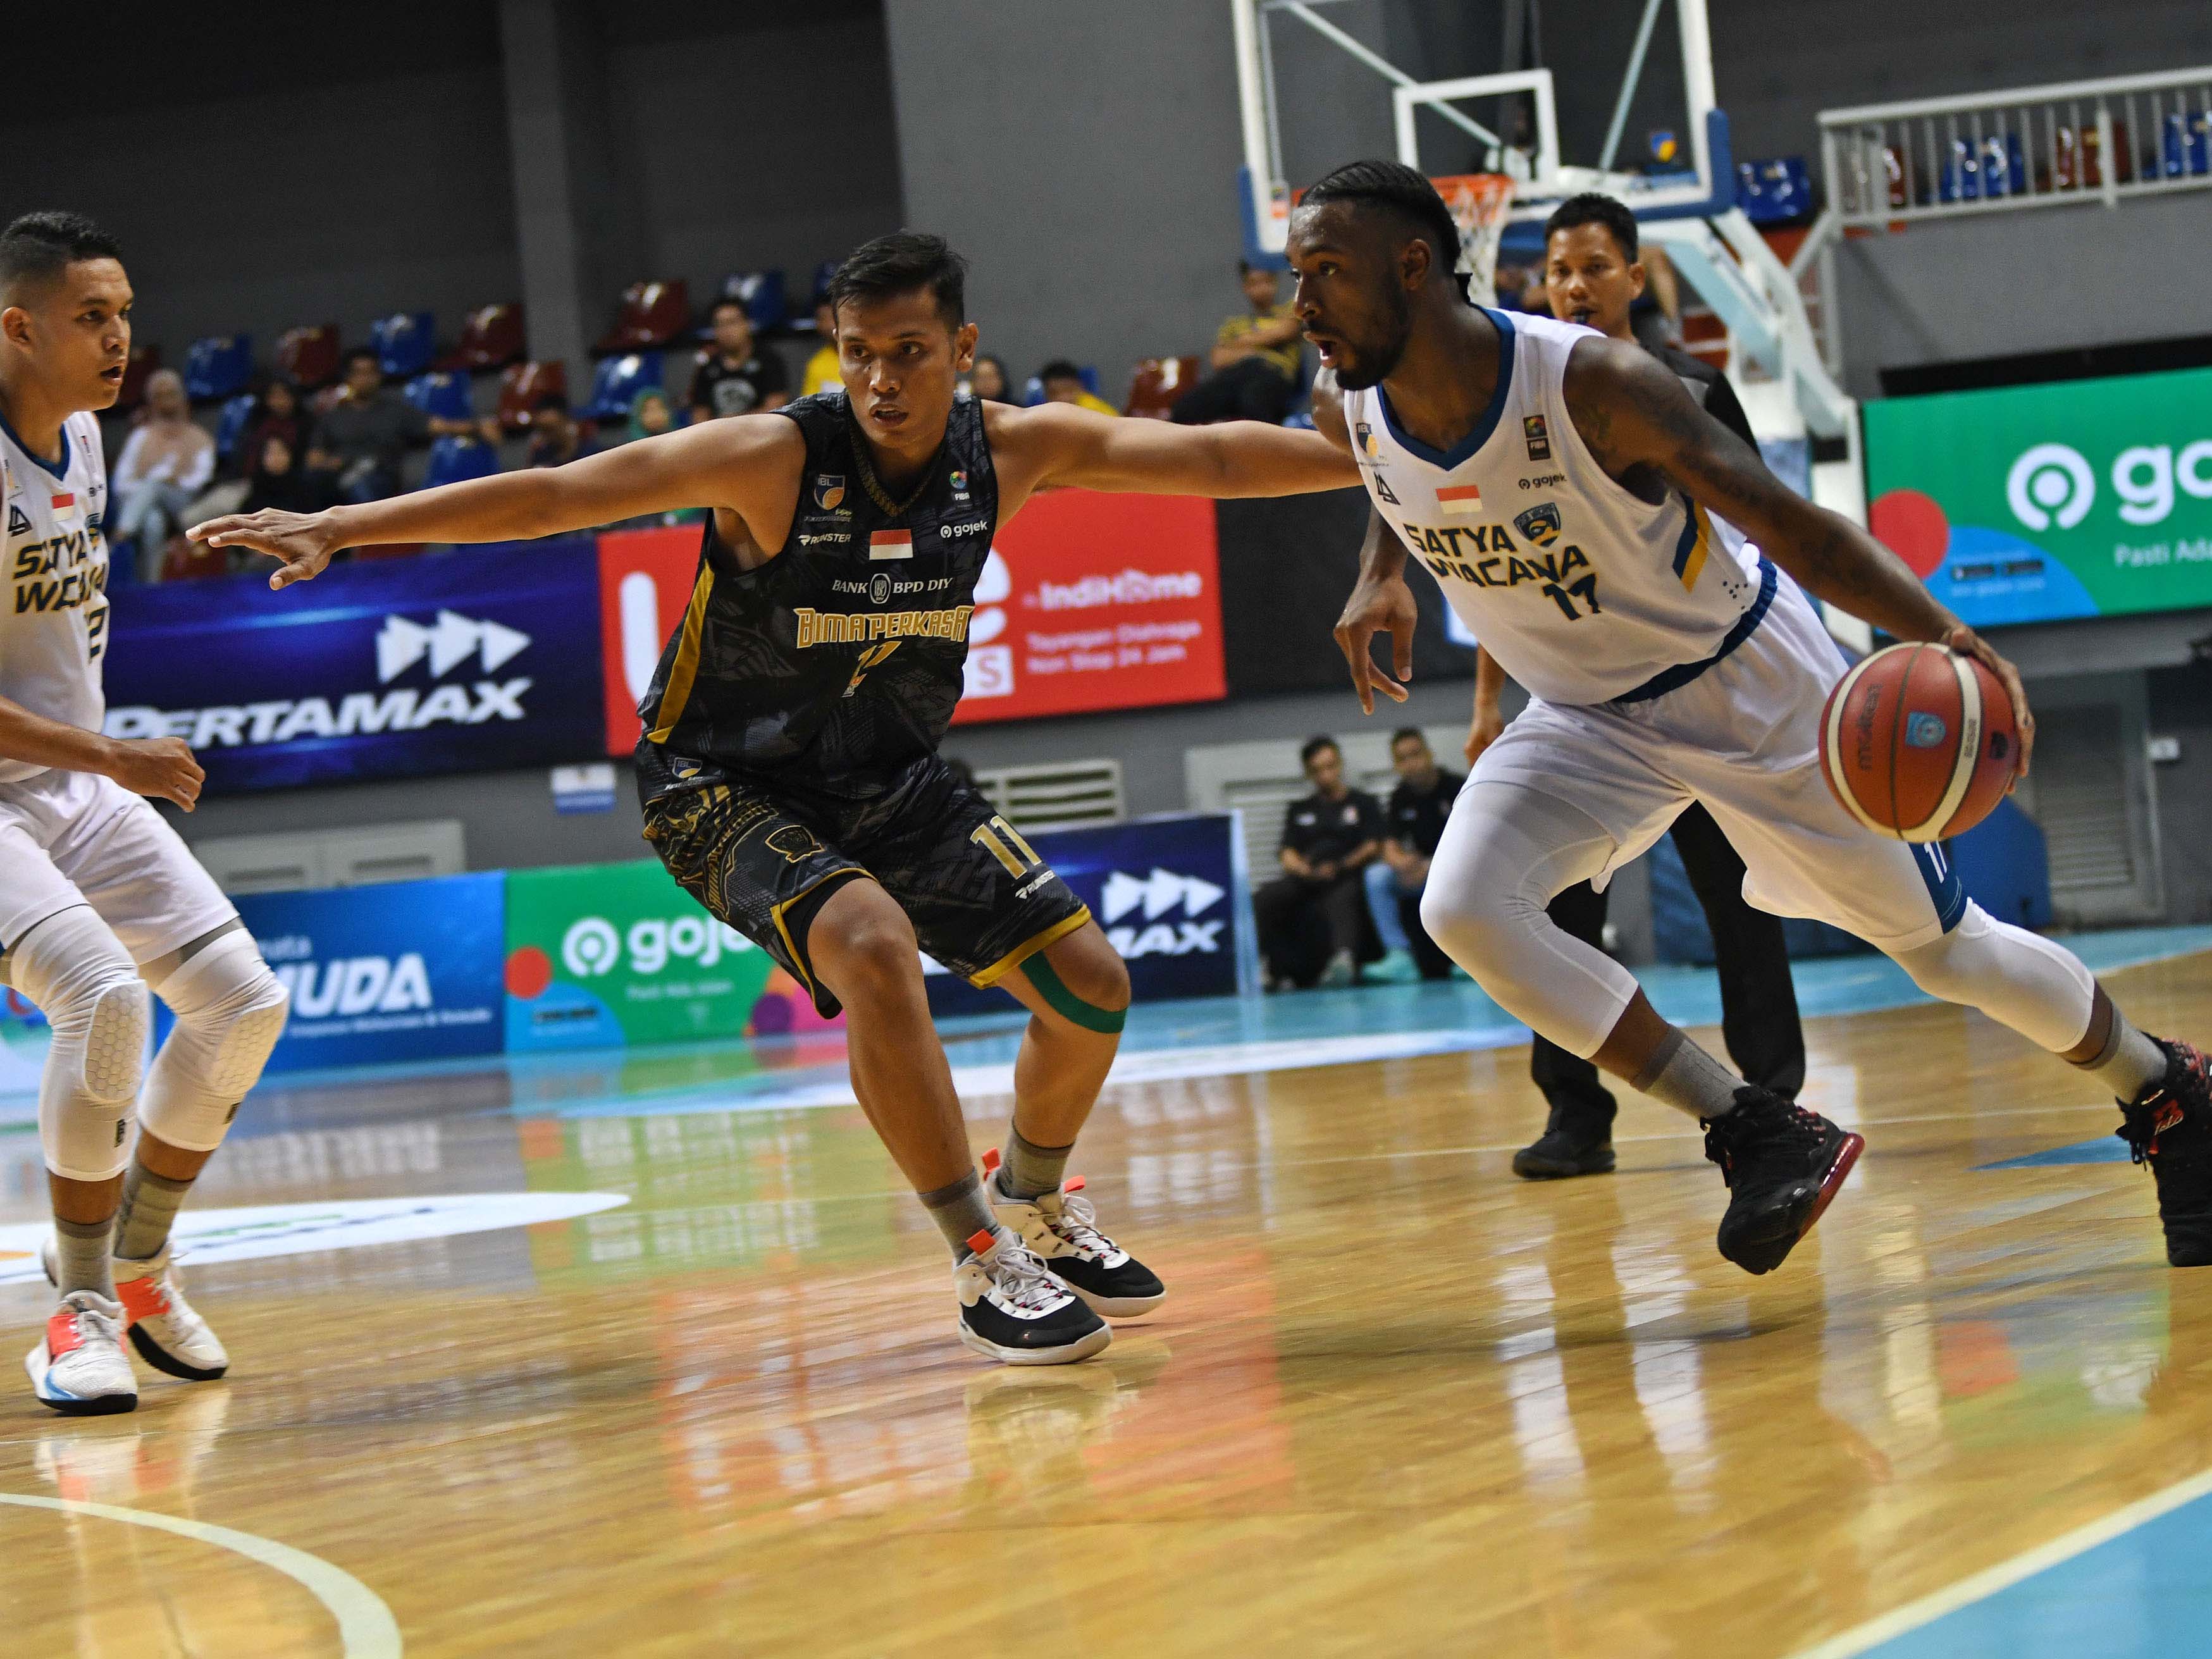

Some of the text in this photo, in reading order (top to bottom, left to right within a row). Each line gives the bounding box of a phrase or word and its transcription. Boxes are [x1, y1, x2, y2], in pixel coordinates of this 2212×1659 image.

[817, 477, 834, 486] IBL
[1533, 473, 1567, 488] gojek
[953, 520, 987, 537] gojek
[810, 533, 851, 545] RUNSTER
[1403, 522, 1517, 557] SATYA
[832, 580, 868, 593] BANK
[893, 581, 924, 593] BPD
[927, 578, 953, 591] DIY
[793, 605, 975, 649] BIMA PERKASA
[102, 676, 532, 750] PERTAMAX
[970, 815, 1042, 880] 11
